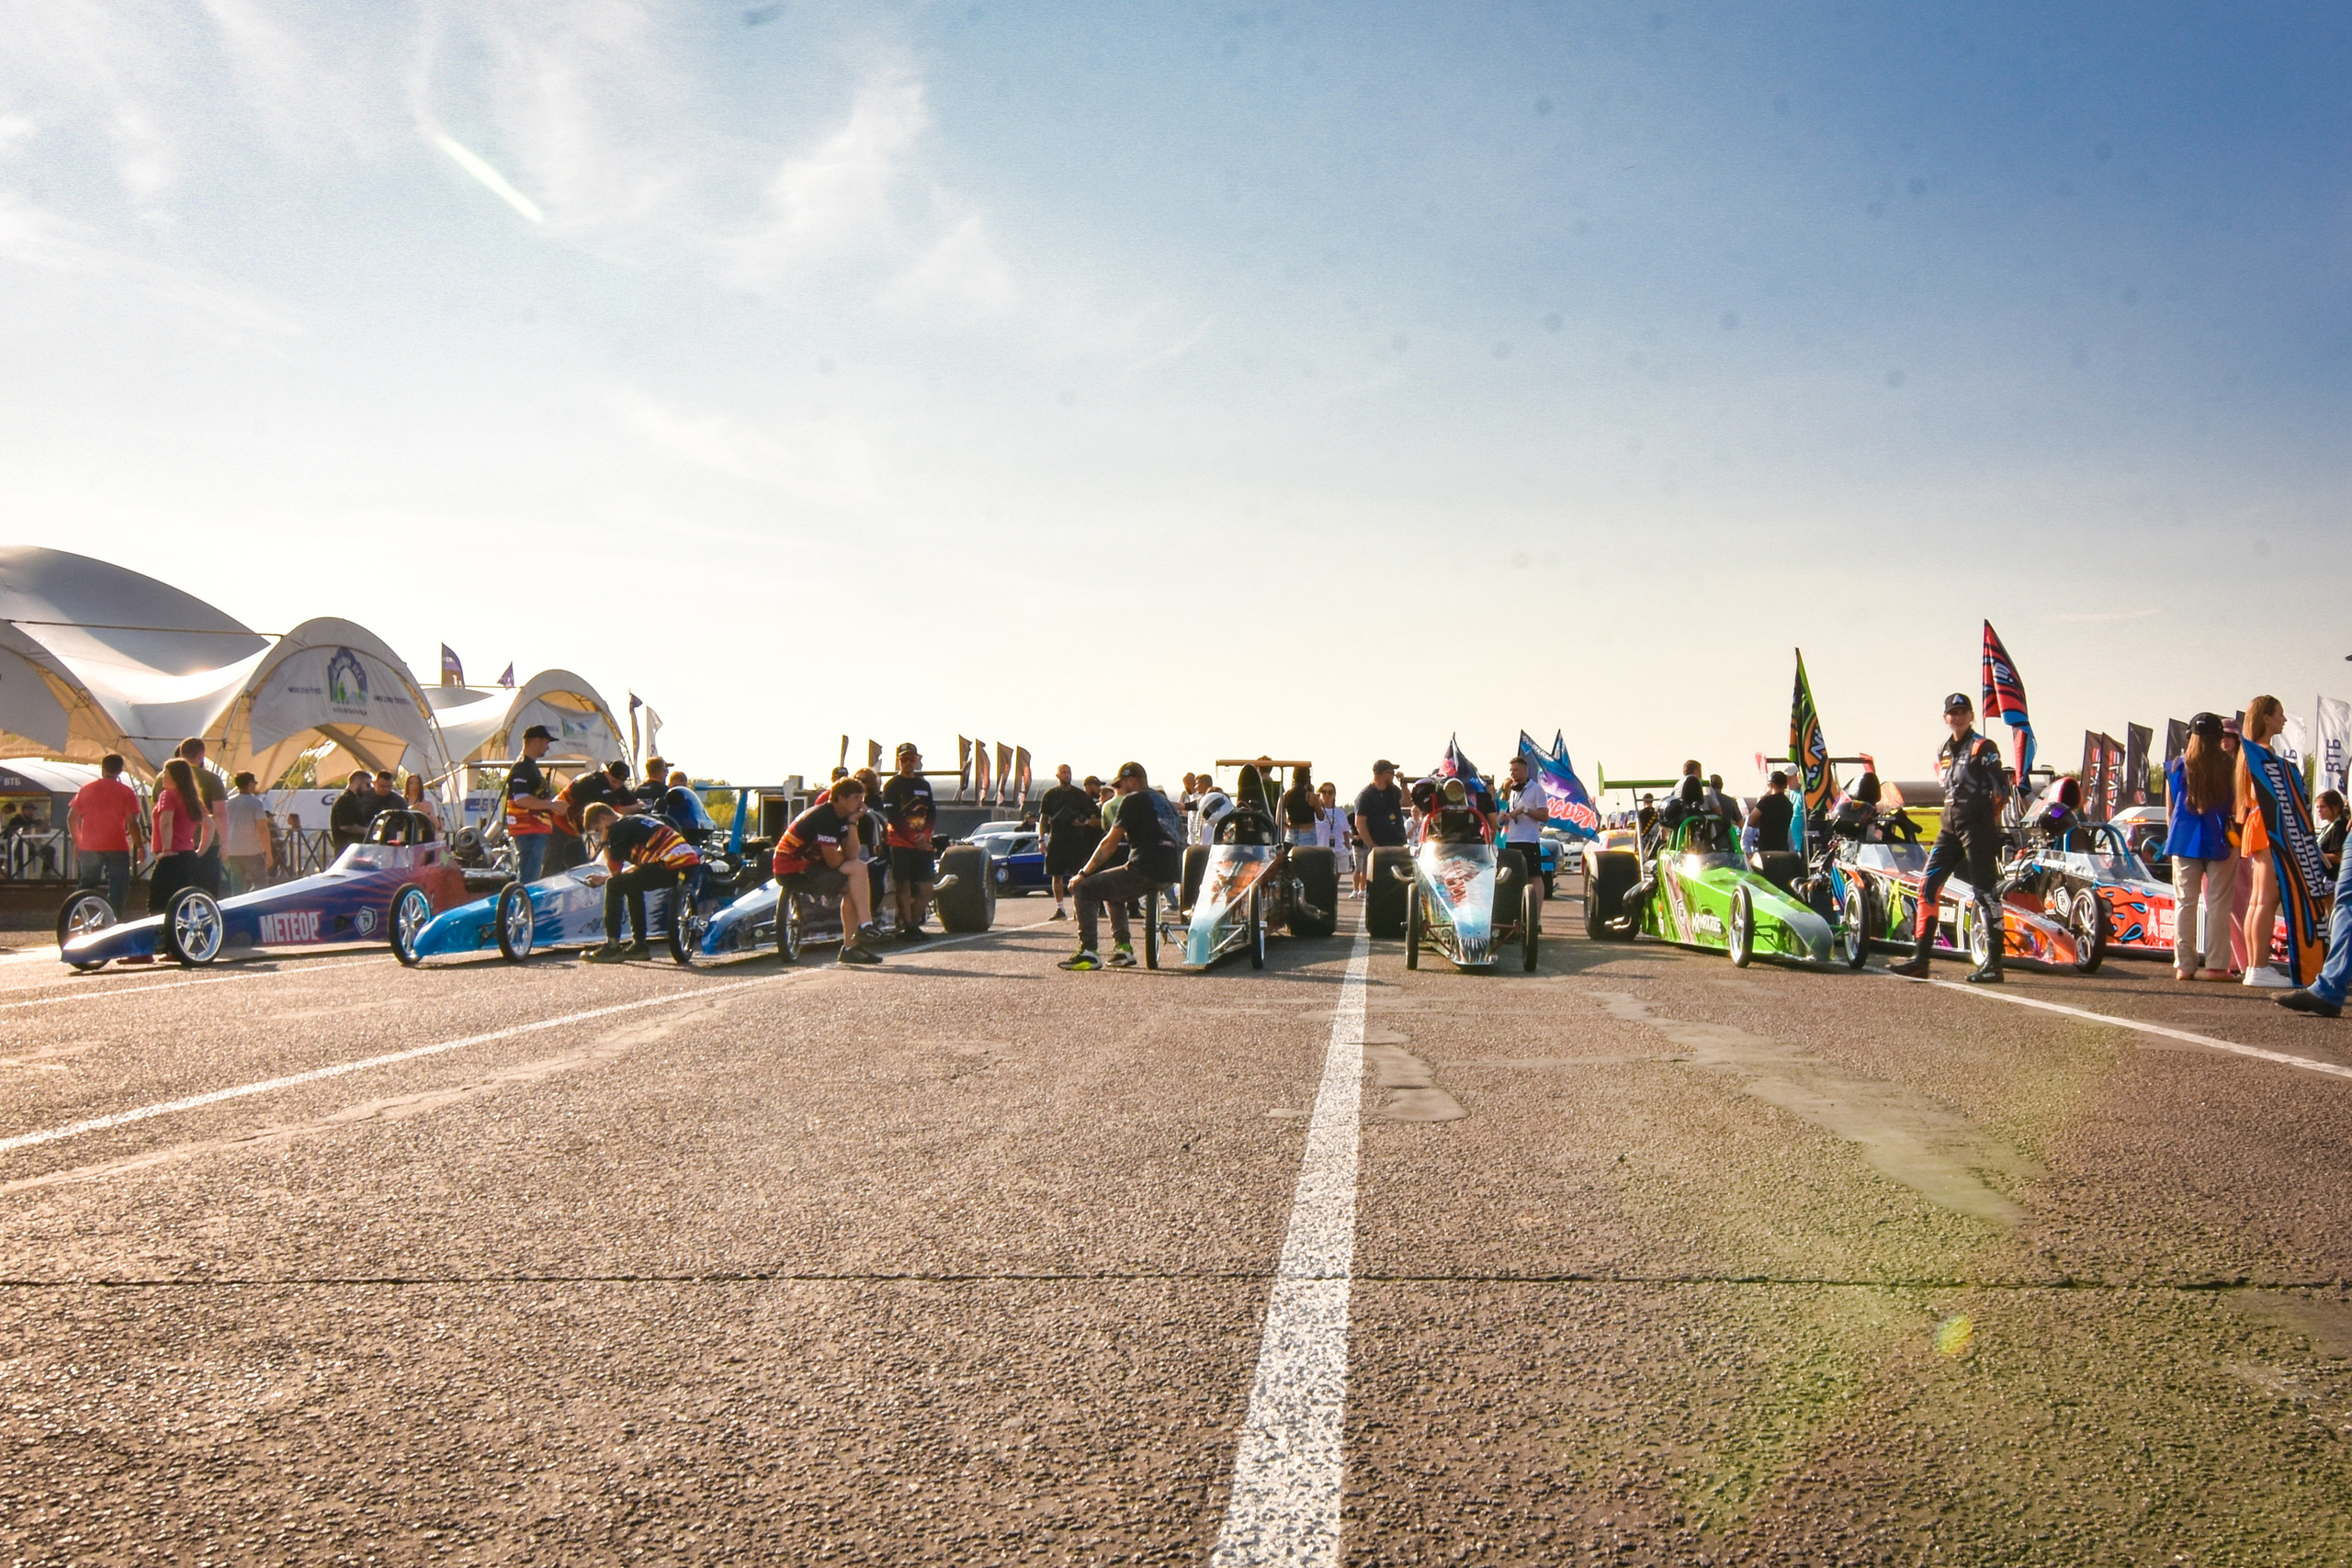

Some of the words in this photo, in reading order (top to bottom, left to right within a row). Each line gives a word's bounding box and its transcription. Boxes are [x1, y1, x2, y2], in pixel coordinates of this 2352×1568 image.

[2325, 738, 2342, 773] ВТБ
[4, 777, 21, 786] ВТБ
[2264, 761, 2321, 897] МОСКОВСКИЙ
[259, 911, 322, 943] МЕТЕОР
